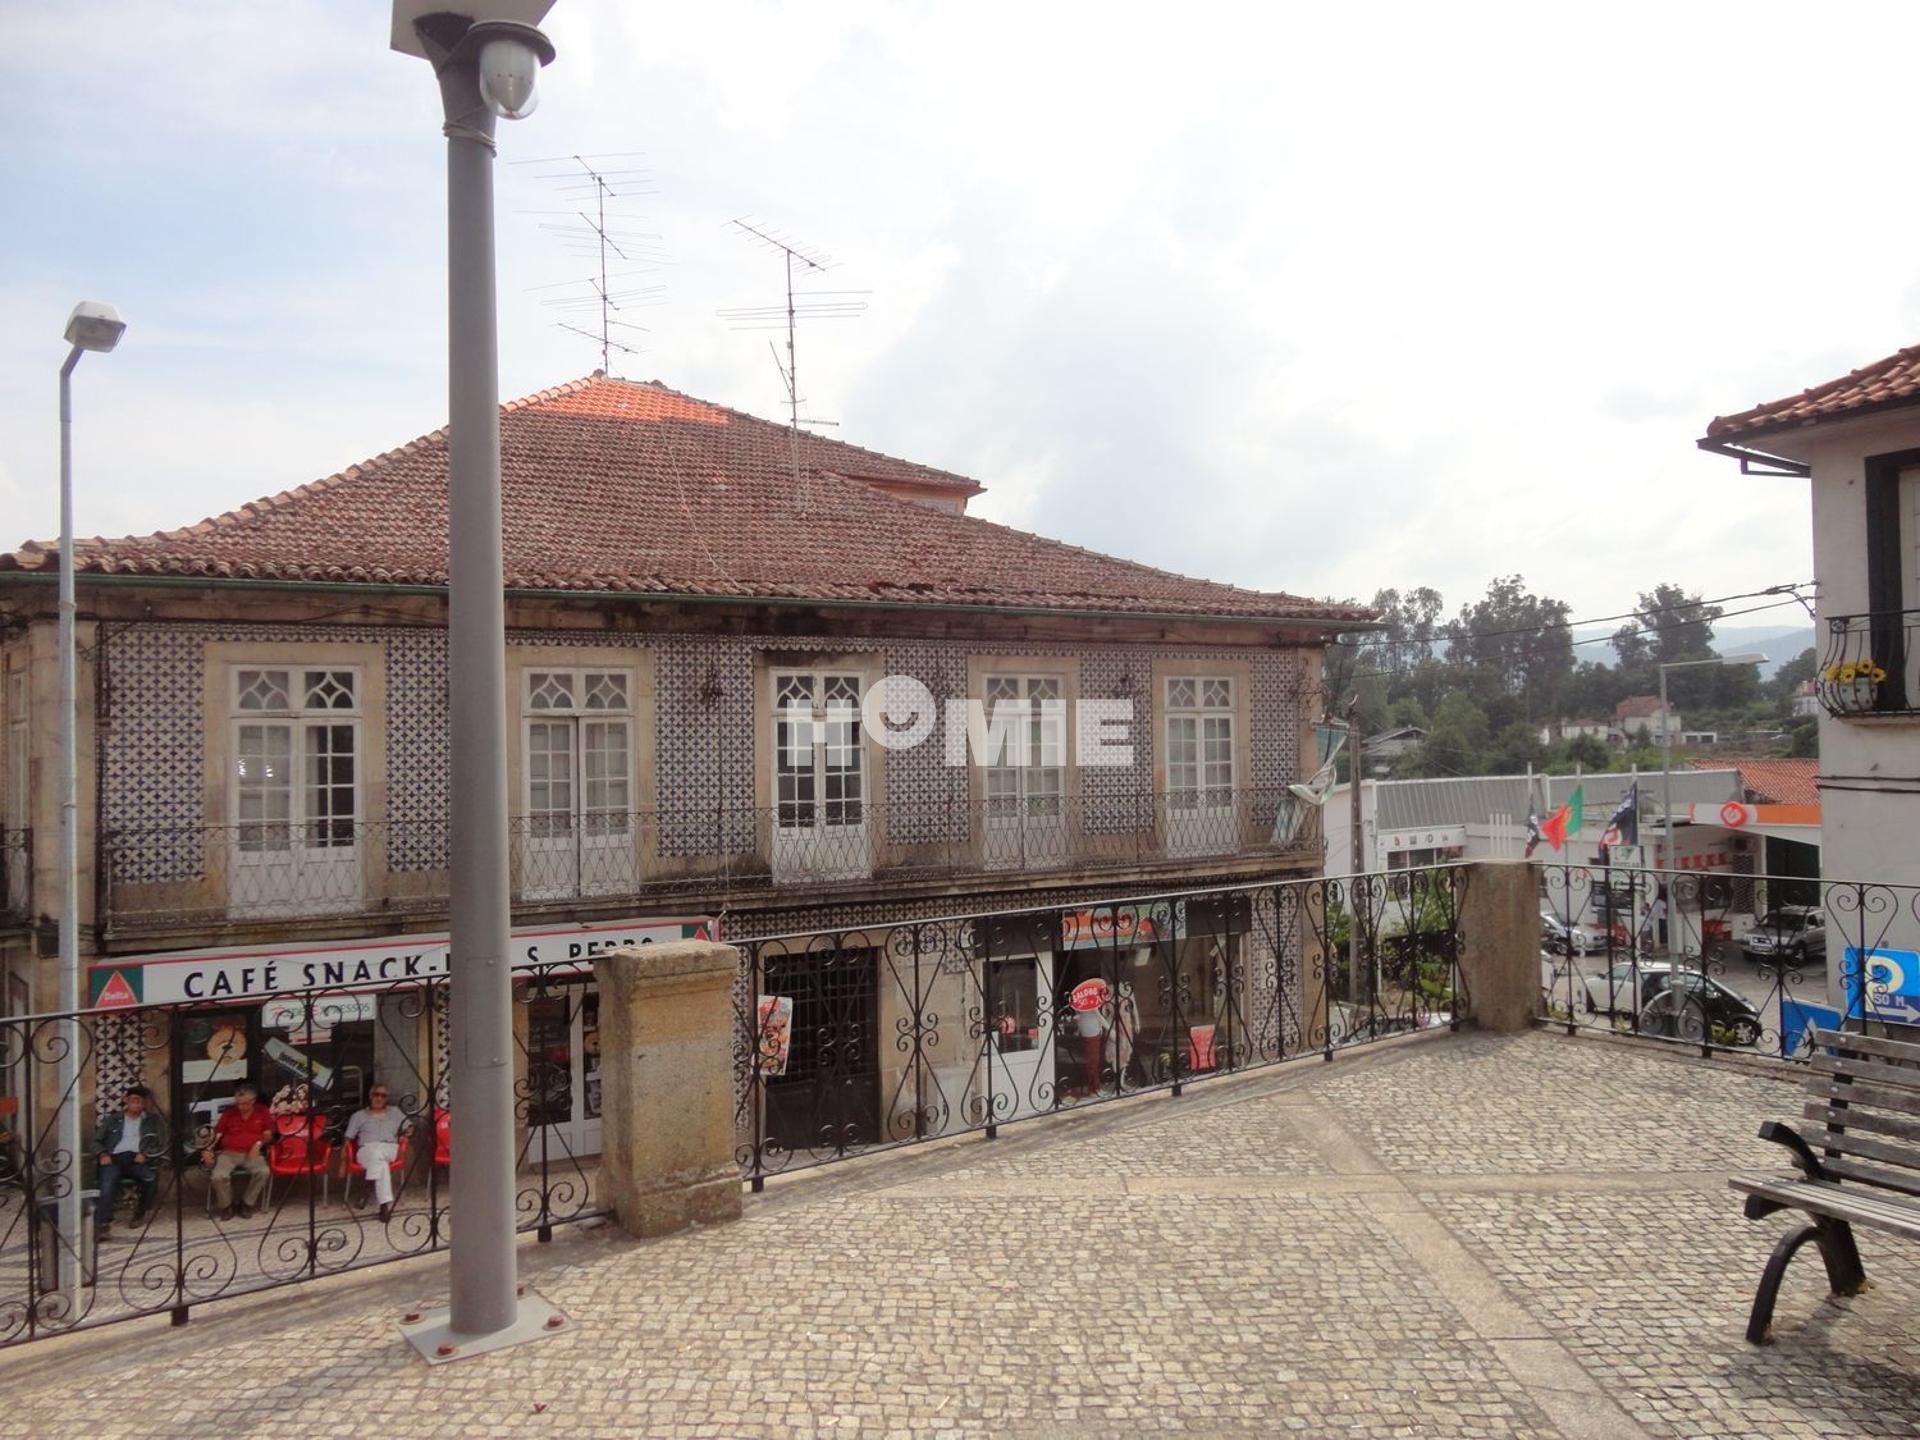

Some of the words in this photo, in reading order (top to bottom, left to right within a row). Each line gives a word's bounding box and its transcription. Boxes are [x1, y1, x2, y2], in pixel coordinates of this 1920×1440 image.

[183, 960, 279, 998] CAFÉ
[303, 952, 450, 987] SNACK-
[104, 991, 129, 1001] Delta
[1895, 995, 1905, 1007] M
